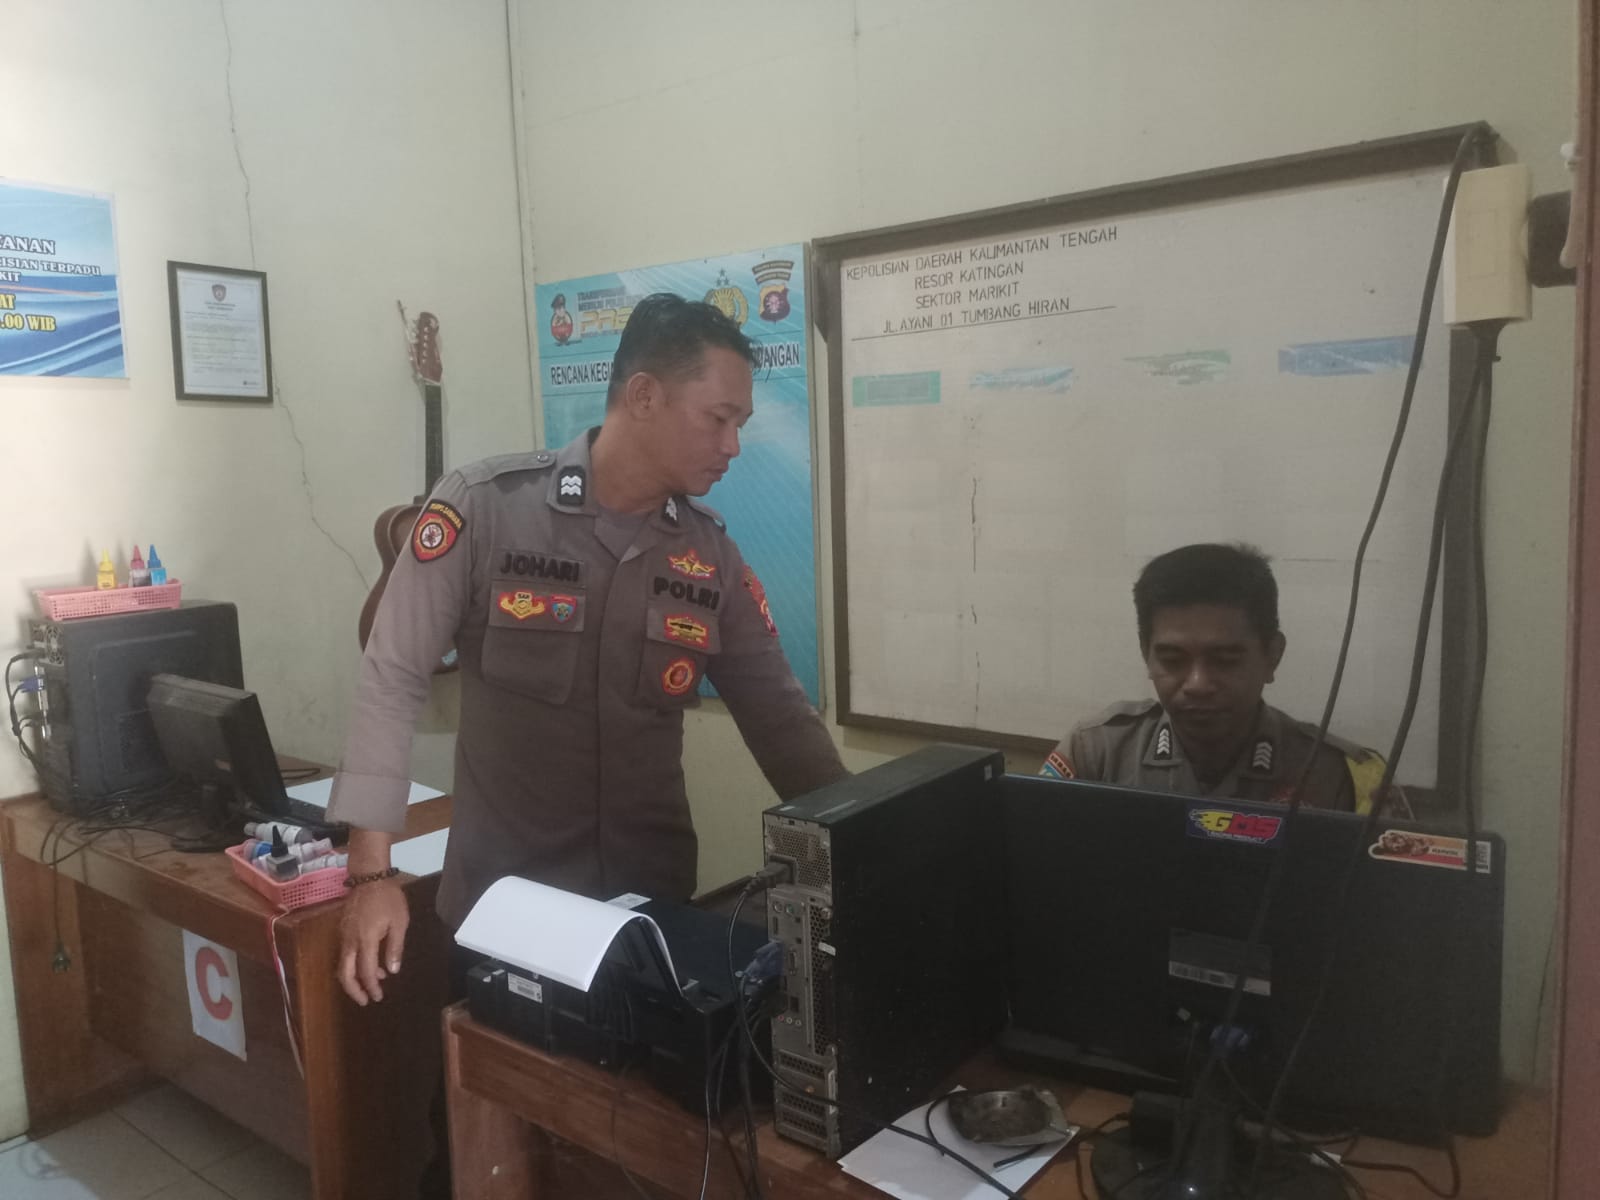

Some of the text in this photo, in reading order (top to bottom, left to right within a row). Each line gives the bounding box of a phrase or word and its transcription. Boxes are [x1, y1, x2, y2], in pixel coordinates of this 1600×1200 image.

[847, 226, 1118, 281] KEPOLISIAN DAERAH KALIMANTAN TENGAH
[40, 260, 101, 277] TERPADU
[914, 261, 1025, 290] RESOR KATINGAN
[915, 281, 1020, 310] SEKTOR MARIKIT
[26, 314, 57, 333] WIB
[580, 306, 636, 332] PRE
[940, 312, 953, 327] 01
[961, 303, 1021, 324] TUMBANG
[1028, 297, 1071, 315] HIRAN
[551, 361, 614, 386] RENCANA KEGI
[500, 552, 580, 582] JOHARI
[653, 576, 720, 611] POLRI
[195, 946, 233, 1020] C
